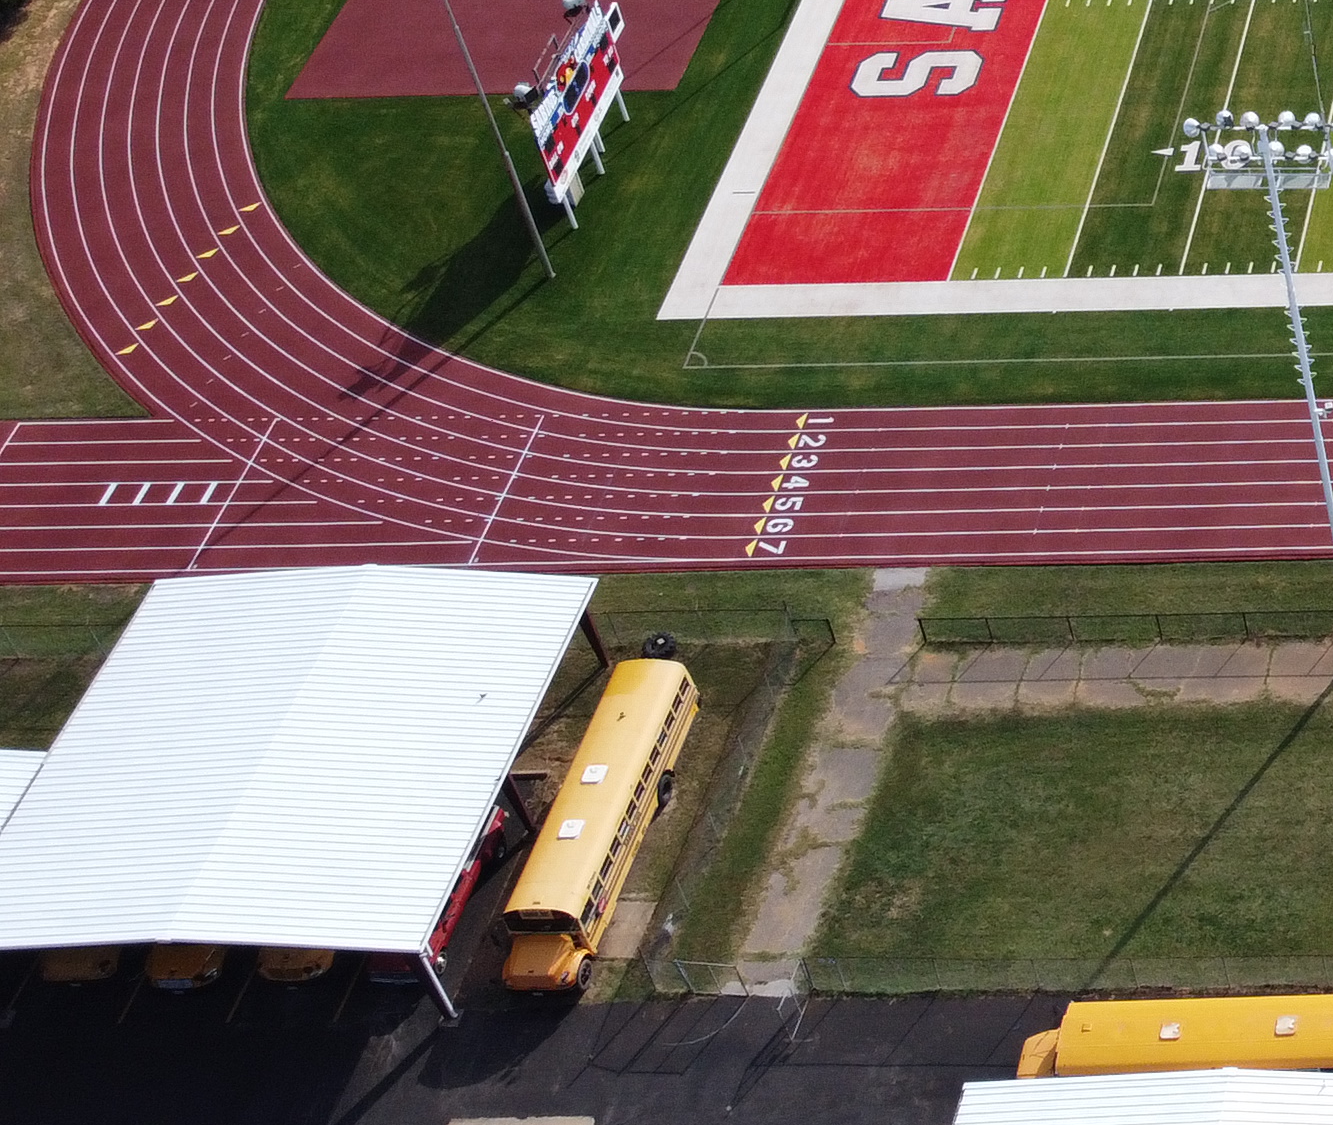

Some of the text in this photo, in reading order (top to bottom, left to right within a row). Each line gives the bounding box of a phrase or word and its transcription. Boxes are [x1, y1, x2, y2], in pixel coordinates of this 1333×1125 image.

[807, 416, 834, 424] 1
[798, 434, 827, 448] 2
[791, 454, 819, 468] 3
[782, 475, 810, 489] 4
[774, 496, 804, 511] 5
[766, 518, 794, 533] 6
[758, 540, 787, 555] 7
